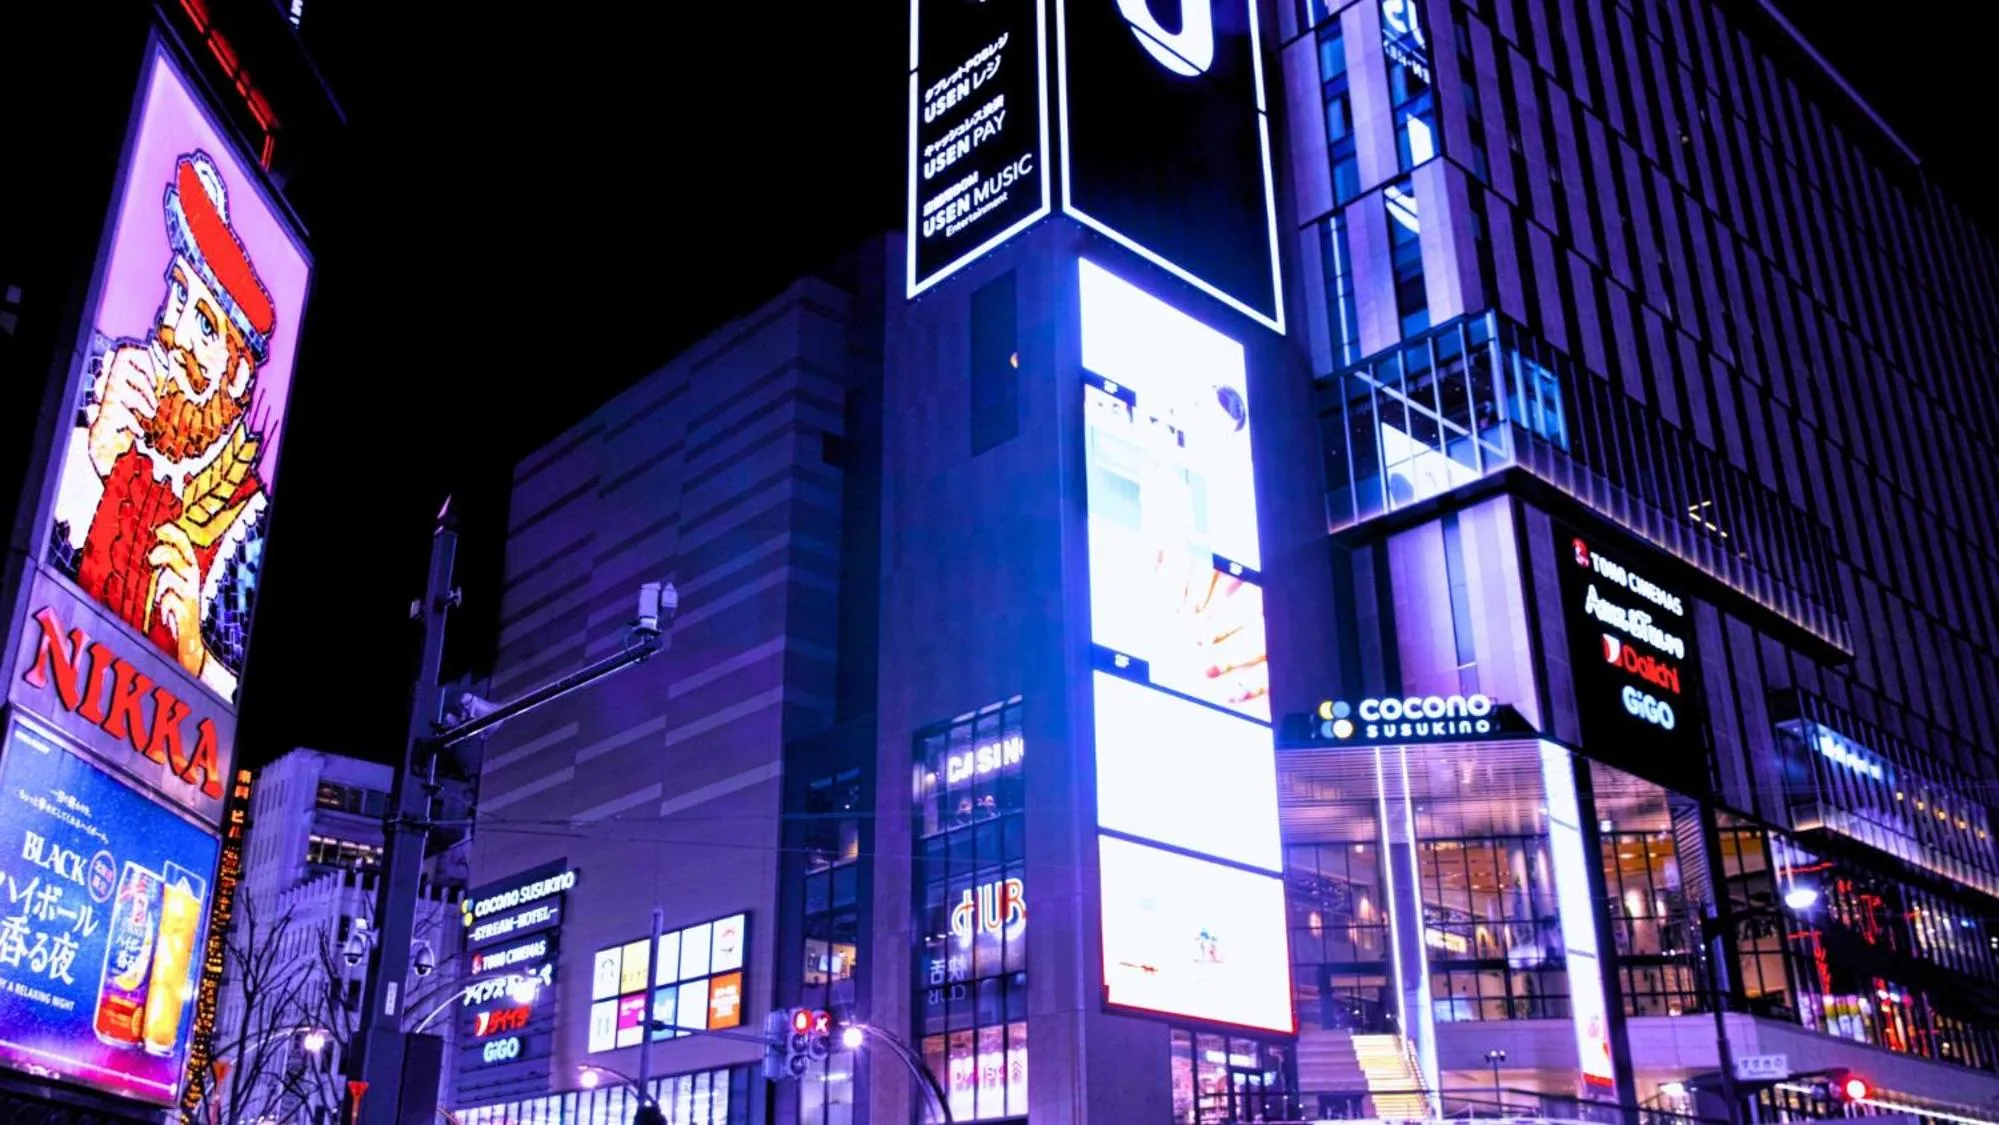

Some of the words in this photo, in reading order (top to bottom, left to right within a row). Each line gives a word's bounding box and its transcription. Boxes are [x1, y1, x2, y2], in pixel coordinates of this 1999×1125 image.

[924, 78, 970, 123] USEN
[973, 54, 1001, 89] レジ
[924, 134, 970, 179] USEN
[973, 109, 1006, 147] PAY
[923, 193, 970, 237] USEN
[973, 153, 1032, 206] MUSIC
[945, 191, 1008, 237] Entertainment
[22, 605, 225, 801] NIKKA
[1366, 719, 1491, 740] SUSUKINO
[22, 830, 88, 887] BLACK
[0, 870, 99, 938] ハイボール
[0, 914, 80, 986] 香る夜
[51, 994, 76, 1012] NIGHT
